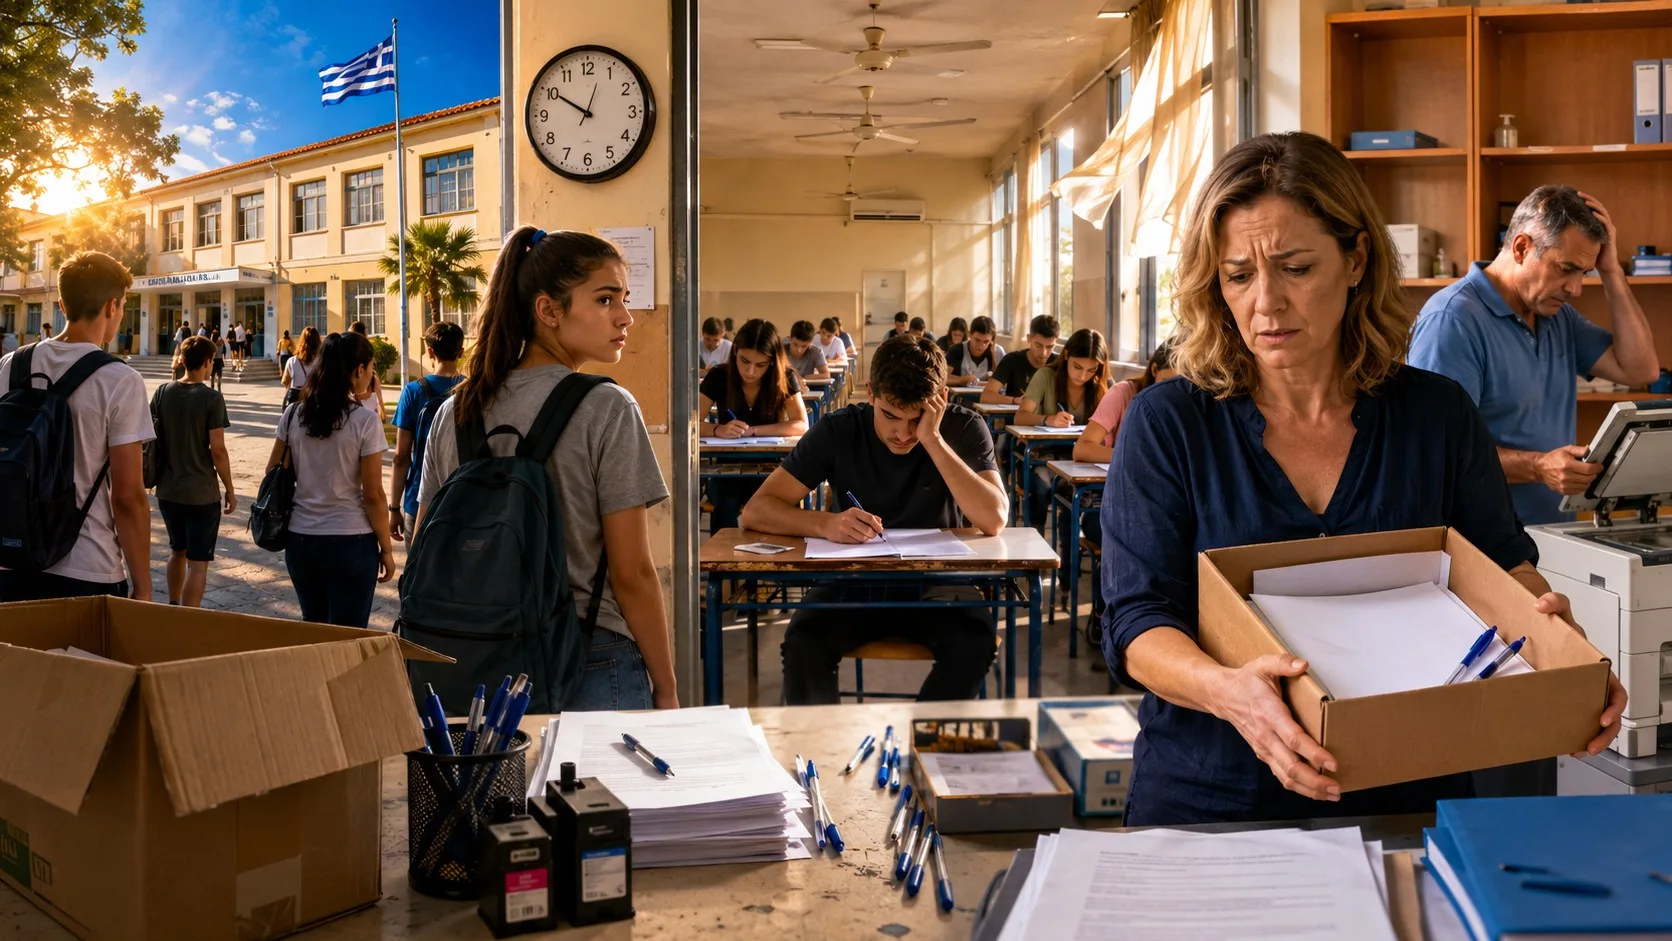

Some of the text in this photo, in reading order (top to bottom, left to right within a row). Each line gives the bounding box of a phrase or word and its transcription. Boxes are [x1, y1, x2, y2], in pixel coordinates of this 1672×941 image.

[581, 61, 594, 75] 12
[606, 66, 612, 80] 1
[561, 69, 572, 83] 11
[547, 87, 559, 100] 10
[621, 82, 630, 96] 2
[540, 109, 548, 122] 9
[628, 105, 637, 119] 3
[546, 131, 555, 145] 8
[620, 129, 630, 142] 4
[562, 147, 571, 160] 7
[583, 152, 592, 166] 6
[605, 146, 614, 159] 5
